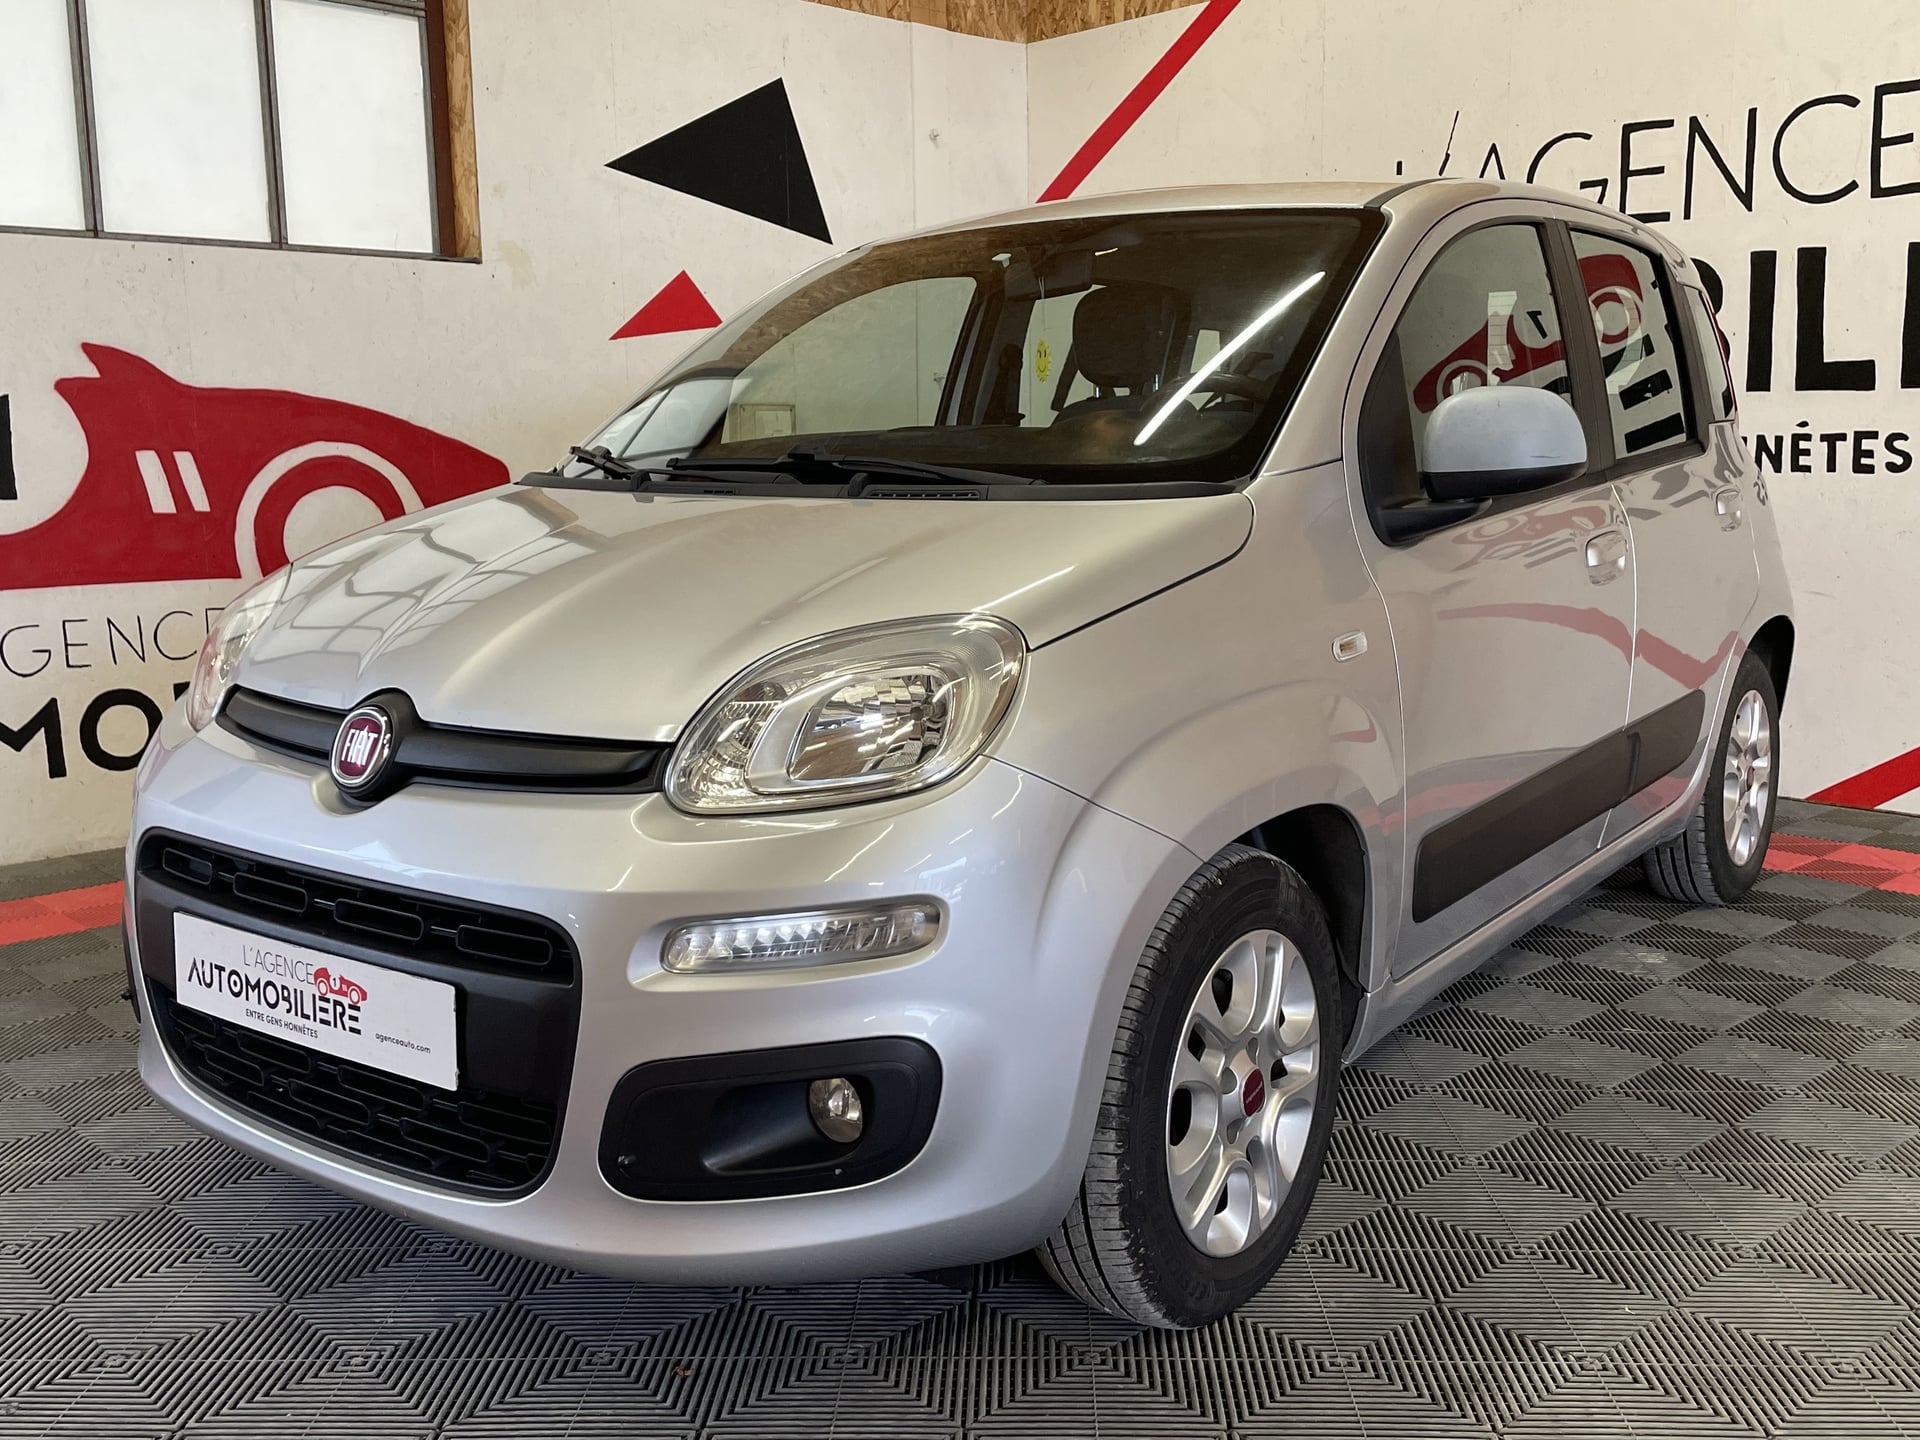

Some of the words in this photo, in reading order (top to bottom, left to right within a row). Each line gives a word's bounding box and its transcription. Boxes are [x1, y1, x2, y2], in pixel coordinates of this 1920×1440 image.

[341, 725, 379, 768] FIAT
[243, 944, 315, 986] L'AGENCE
[246, 1008, 265, 1023] ENTRE
[266, 1015, 283, 1028] GENS
[375, 1032, 431, 1054] agenceauto.com
